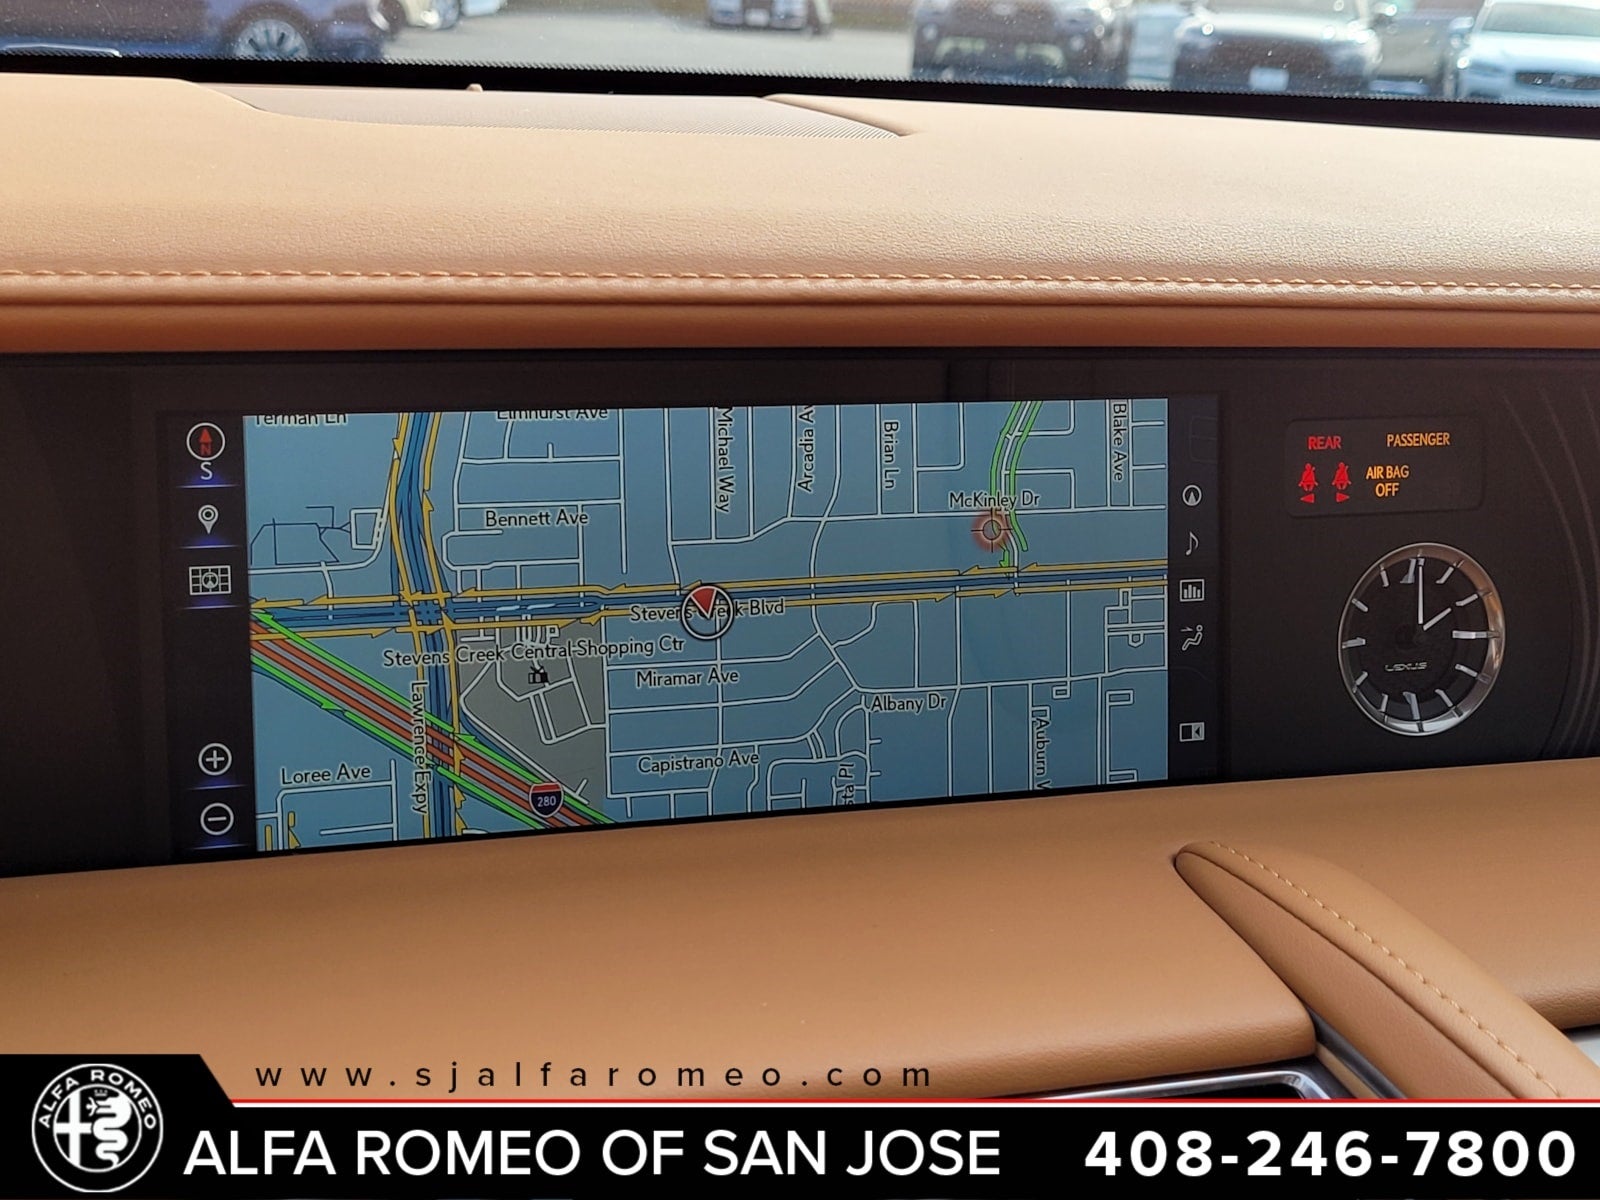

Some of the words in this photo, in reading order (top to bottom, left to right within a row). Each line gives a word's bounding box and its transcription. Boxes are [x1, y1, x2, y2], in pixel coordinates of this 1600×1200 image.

[576, 408, 608, 419] Ave
[1112, 403, 1127, 446] Blake
[717, 408, 735, 470] Michael
[883, 420, 898, 464] Brian
[1308, 436, 1341, 450] REAR
[1386, 432, 1451, 447] PASSENGER
[798, 429, 814, 492] Arcadia
[1112, 450, 1127, 481] Ave
[200, 461, 213, 481] S
[884, 469, 897, 489] Ln
[1365, 465, 1386, 480] AIR
[1386, 464, 1410, 479] BAG
[716, 480, 735, 512] Way
[949, 492, 1017, 509] McKinley
[1022, 491, 1040, 507] Dr
[1375, 482, 1400, 498] OFF
[486, 510, 550, 527] Bennett
[556, 511, 588, 525] Ave
[750, 598, 785, 616] Blvd
[383, 649, 450, 667] Stevens
[456, 646, 505, 662] Creek
[511, 642, 572, 661] Central
[576, 639, 654, 658] Shopping
[659, 636, 684, 651] Ctr
[636, 671, 702, 688] Miramar
[708, 669, 739, 684] Ave
[871, 694, 923, 714] Albany
[929, 693, 946, 709] Dr
[411, 682, 428, 765] Lawrence
[1035, 718, 1050, 775] Auburn
[638, 755, 724, 776] Capistrano
[729, 751, 760, 766] Ave
[839, 763, 855, 778] Pl
[281, 767, 331, 784] Loree
[337, 764, 371, 779] Ave
[413, 772, 431, 814] Expy
[537, 796, 556, 808] 280
